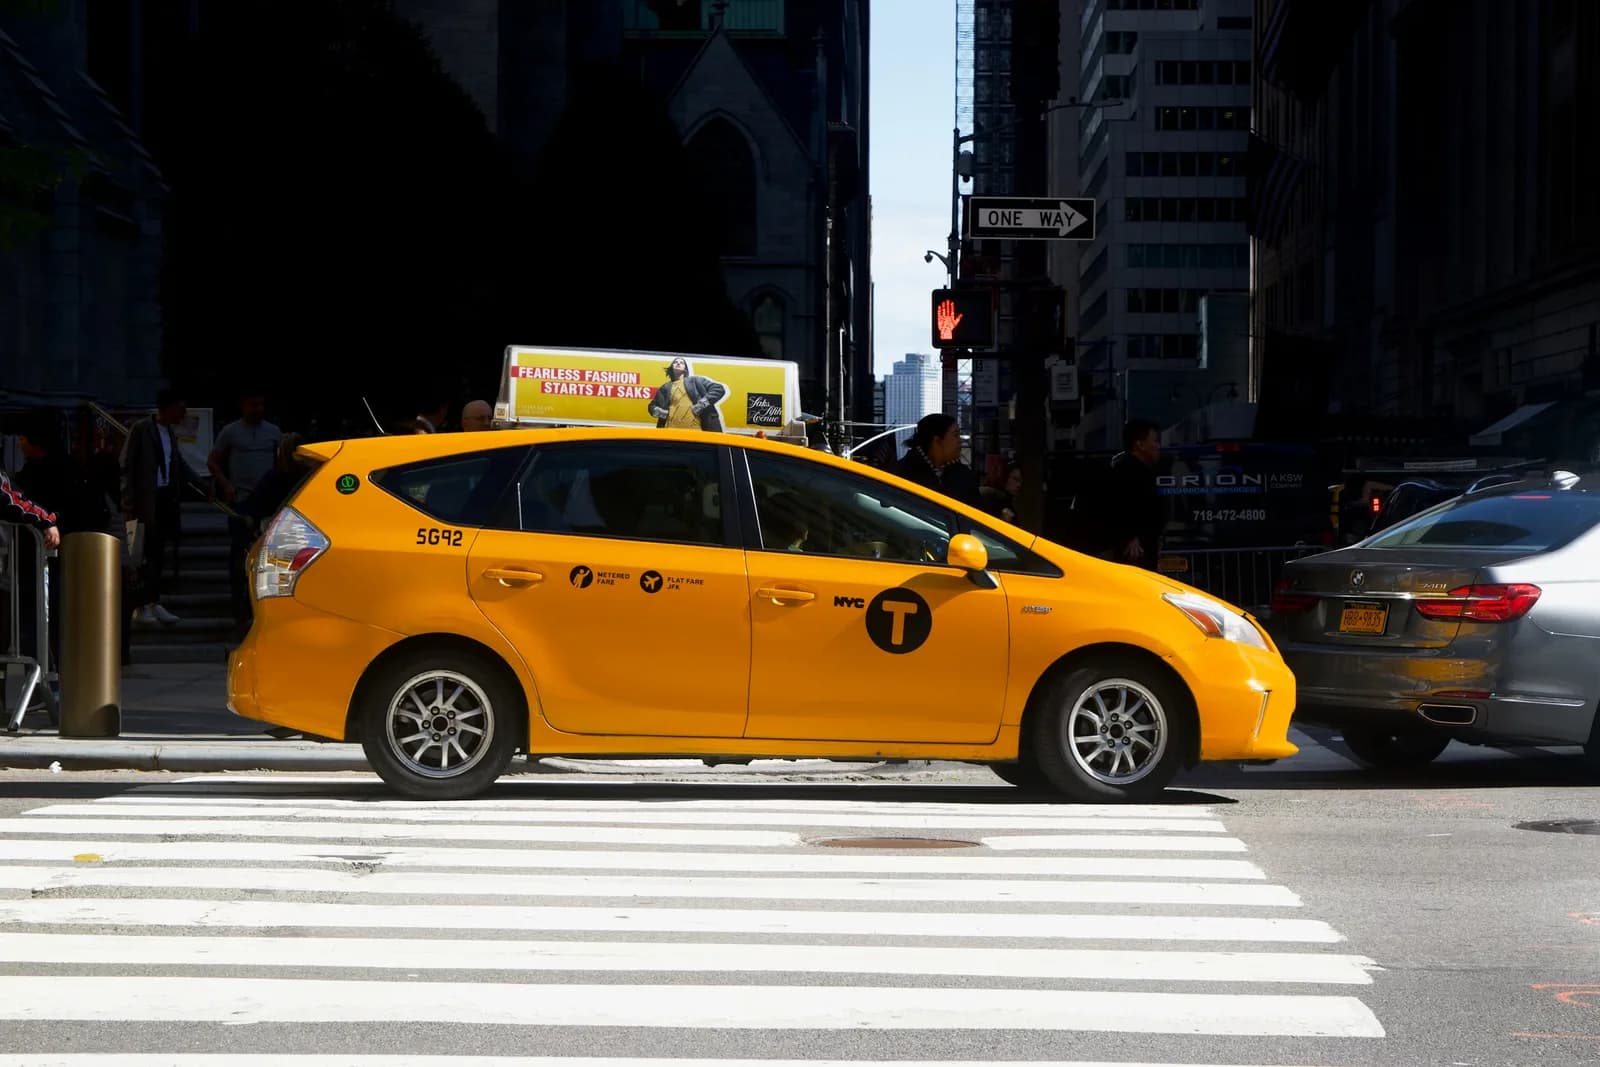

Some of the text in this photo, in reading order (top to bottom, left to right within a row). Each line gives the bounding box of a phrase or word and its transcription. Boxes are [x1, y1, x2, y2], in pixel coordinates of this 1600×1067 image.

[988, 211, 1076, 227] ONE WAY
[518, 366, 638, 385] FEARLESS FASHION
[543, 381, 651, 399] STARTS AT SAKS
[1155, 473, 1262, 487] ORION
[1270, 473, 1304, 482] A KSW
[1192, 510, 1266, 521] 718-472-4800
[416, 528, 463, 546] 5G92
[597, 572, 630, 580] METERED
[597, 578, 615, 586] FARE
[686, 578, 704, 586] FARE
[833, 595, 865, 609] NYC
[881, 600, 918, 646] T
